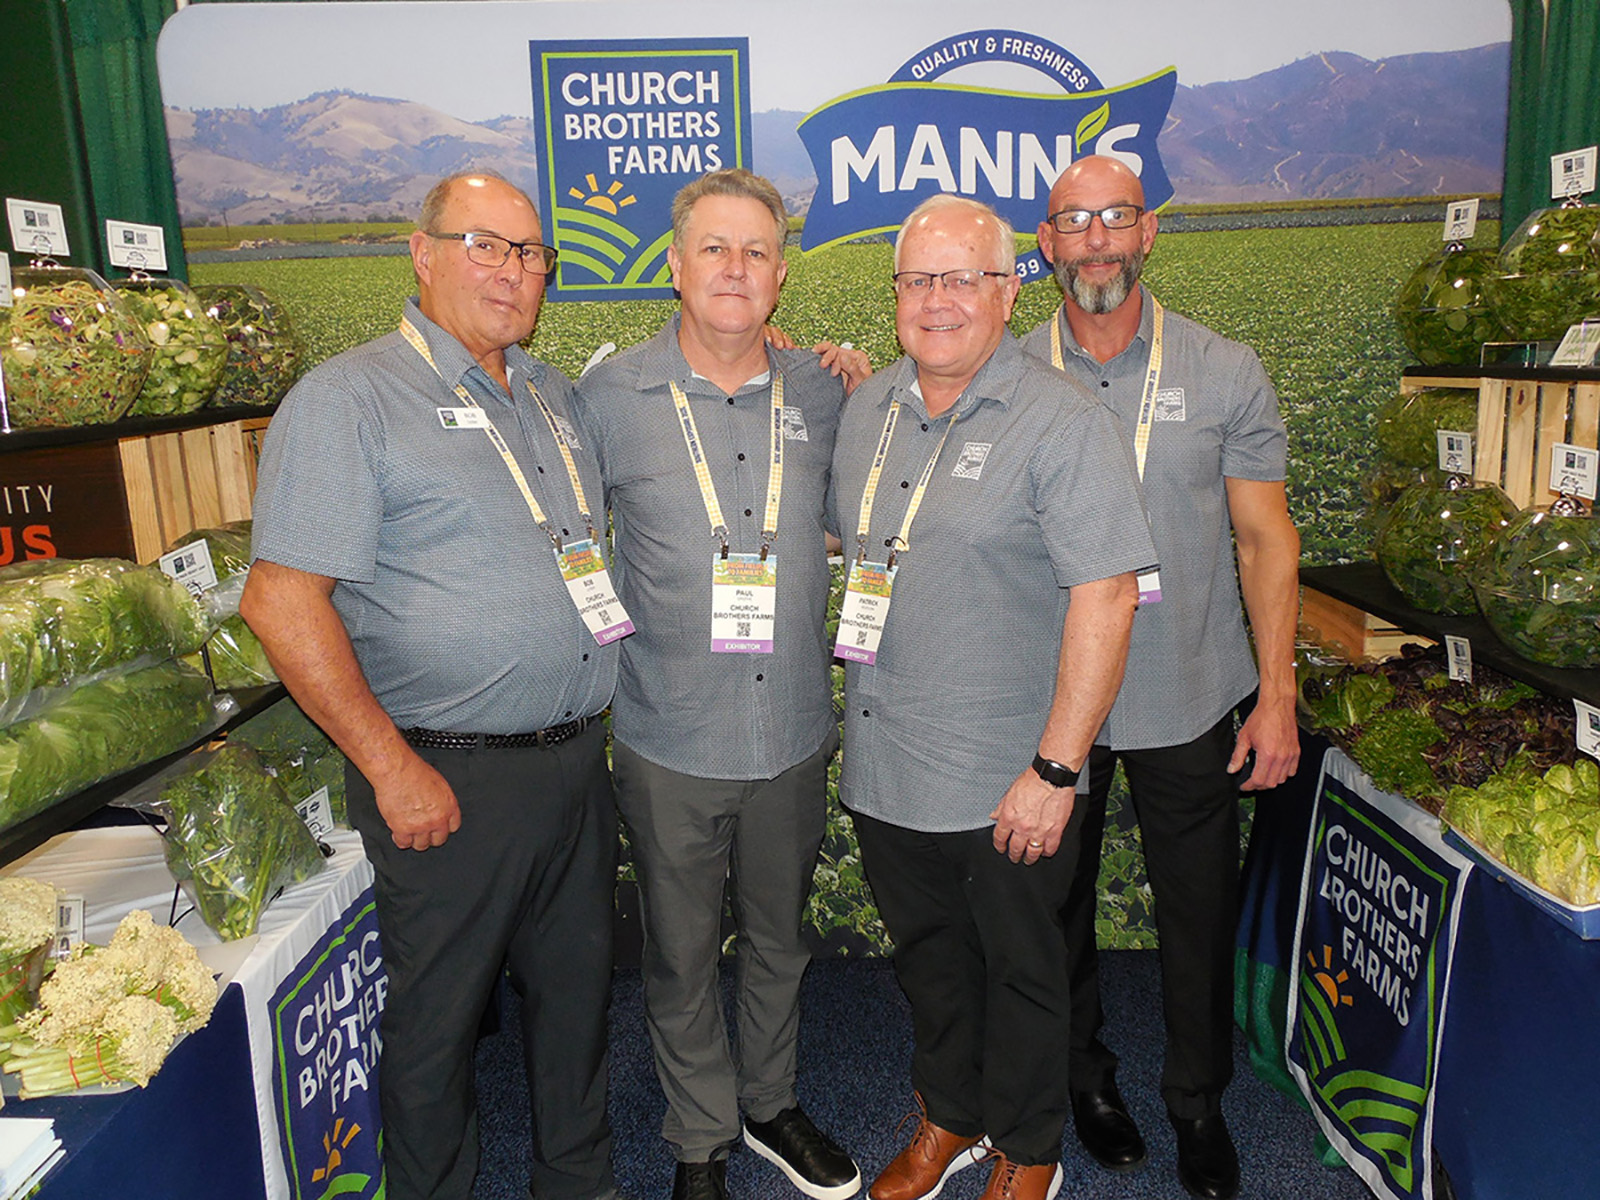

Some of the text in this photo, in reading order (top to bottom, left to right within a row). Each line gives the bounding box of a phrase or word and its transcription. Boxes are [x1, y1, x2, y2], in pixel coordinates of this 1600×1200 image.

[911, 37, 1090, 91] QUALITY & FRESHNESS
[562, 71, 720, 107] CHURCH
[565, 111, 721, 140] BROTHERS
[608, 143, 722, 175] FARMS
[585, 593, 604, 603] CHURCH
[859, 598, 879, 606] PATRICK
[713, 612, 750, 620] BROTHERS
[841, 618, 868, 629] BROTHERS
[856, 613, 875, 621] CHURCH
[1325, 825, 1430, 938] CHURCH
[1342, 926, 1409, 1026] FARMS
[295, 931, 382, 1056] CHURC
[299, 975, 389, 1109] BROTHER
